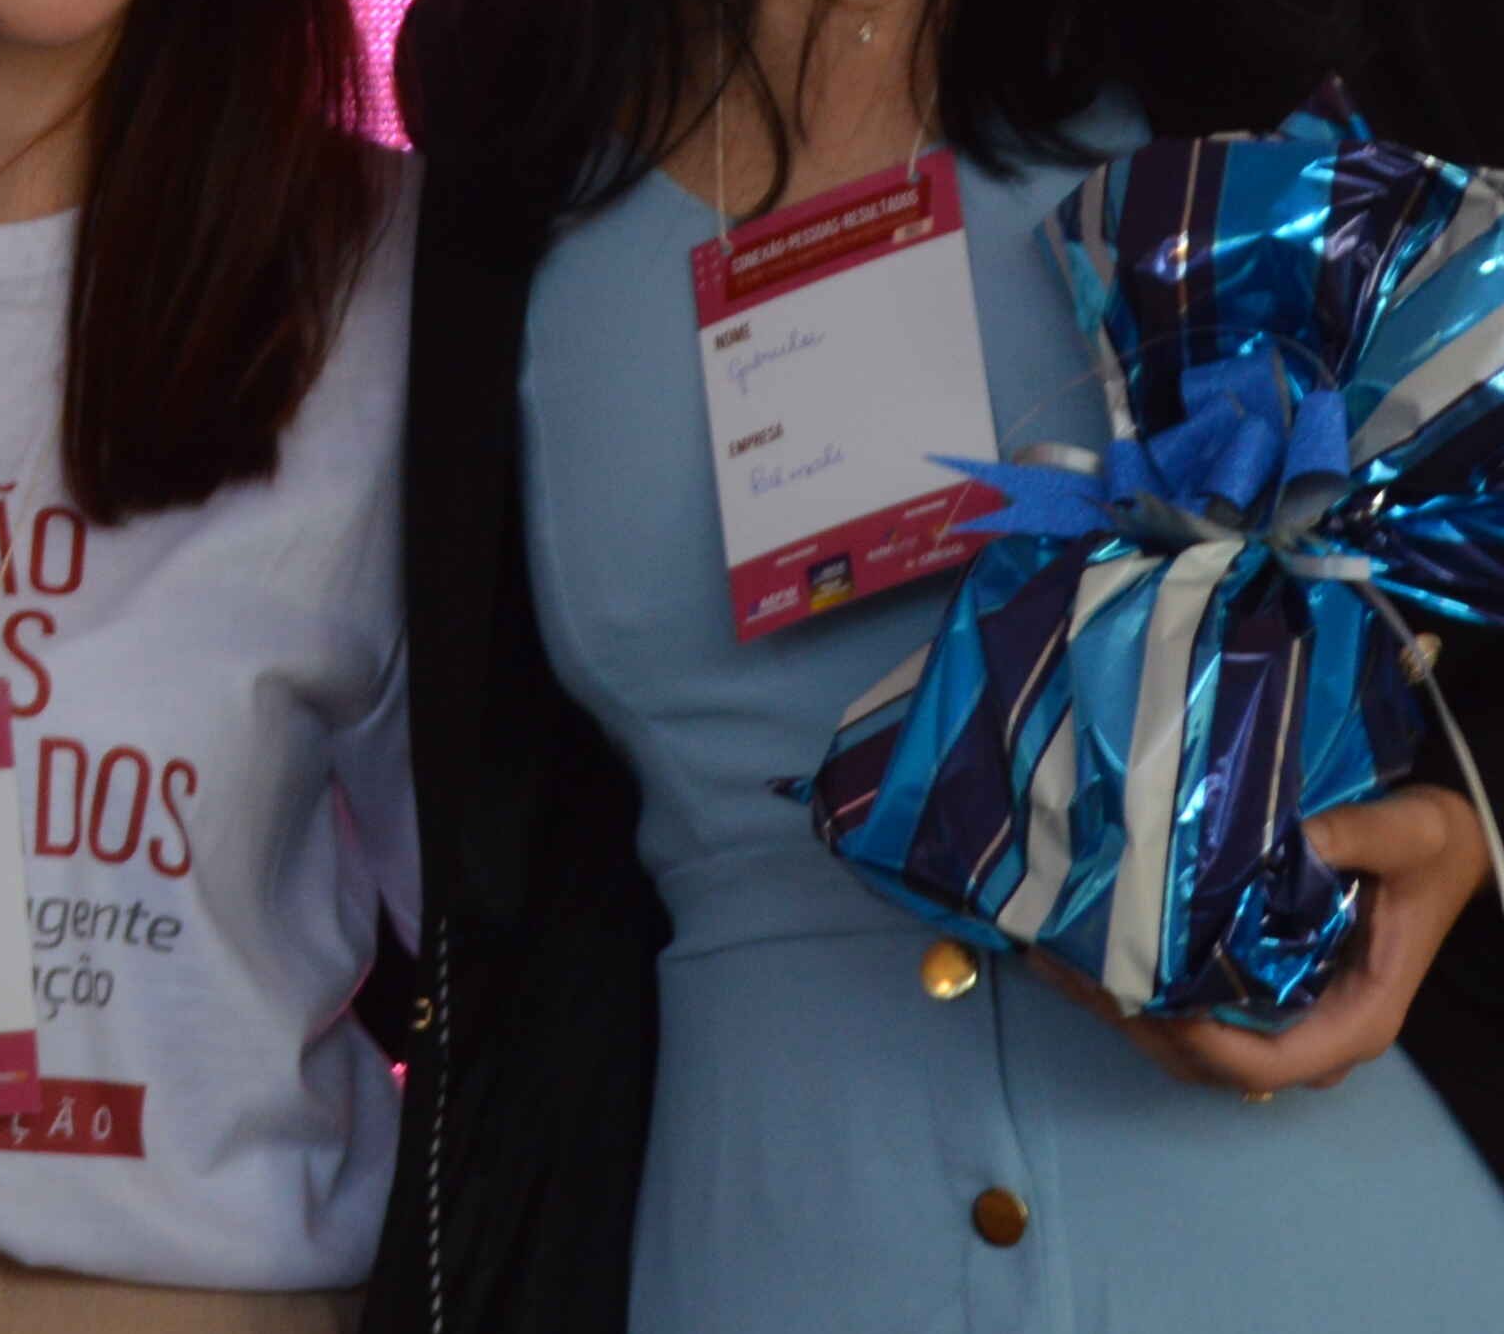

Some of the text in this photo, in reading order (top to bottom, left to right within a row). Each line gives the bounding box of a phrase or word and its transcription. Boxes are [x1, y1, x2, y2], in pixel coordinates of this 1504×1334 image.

[714, 322, 752, 351] NOME
[728, 422, 784, 459] EMPRESA
[26, 896, 184, 955] gente
